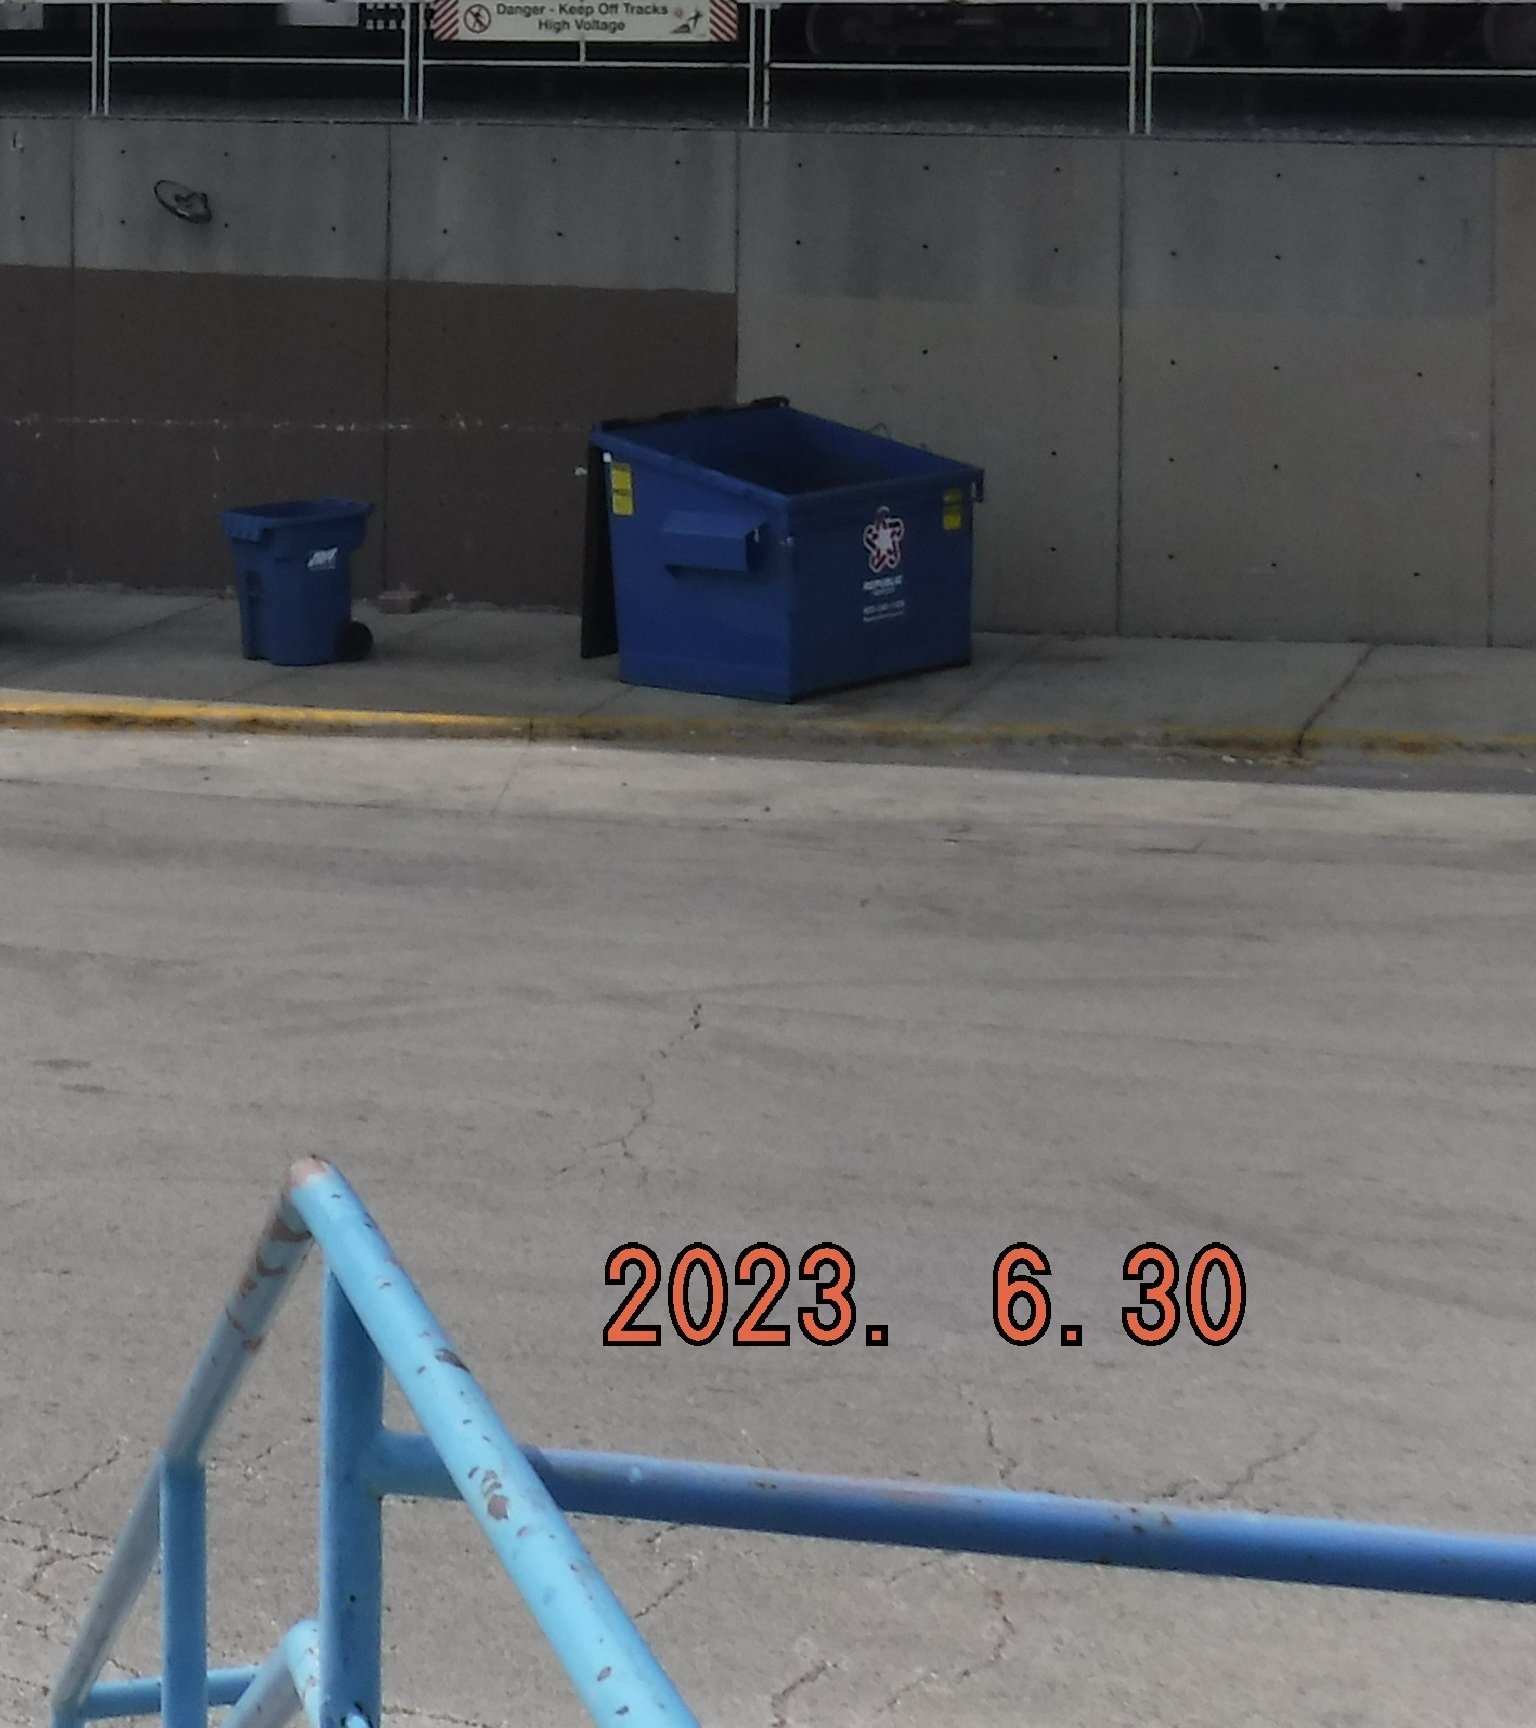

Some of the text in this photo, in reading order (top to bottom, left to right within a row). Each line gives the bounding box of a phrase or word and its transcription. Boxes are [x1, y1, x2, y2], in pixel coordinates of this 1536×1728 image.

[496, 3, 546, 18] Danger
[558, 3, 595, 17] Keep
[598, 2, 619, 15] Off
[623, 2, 669, 15] Tracks
[538, 18, 626, 34] High Voltage
